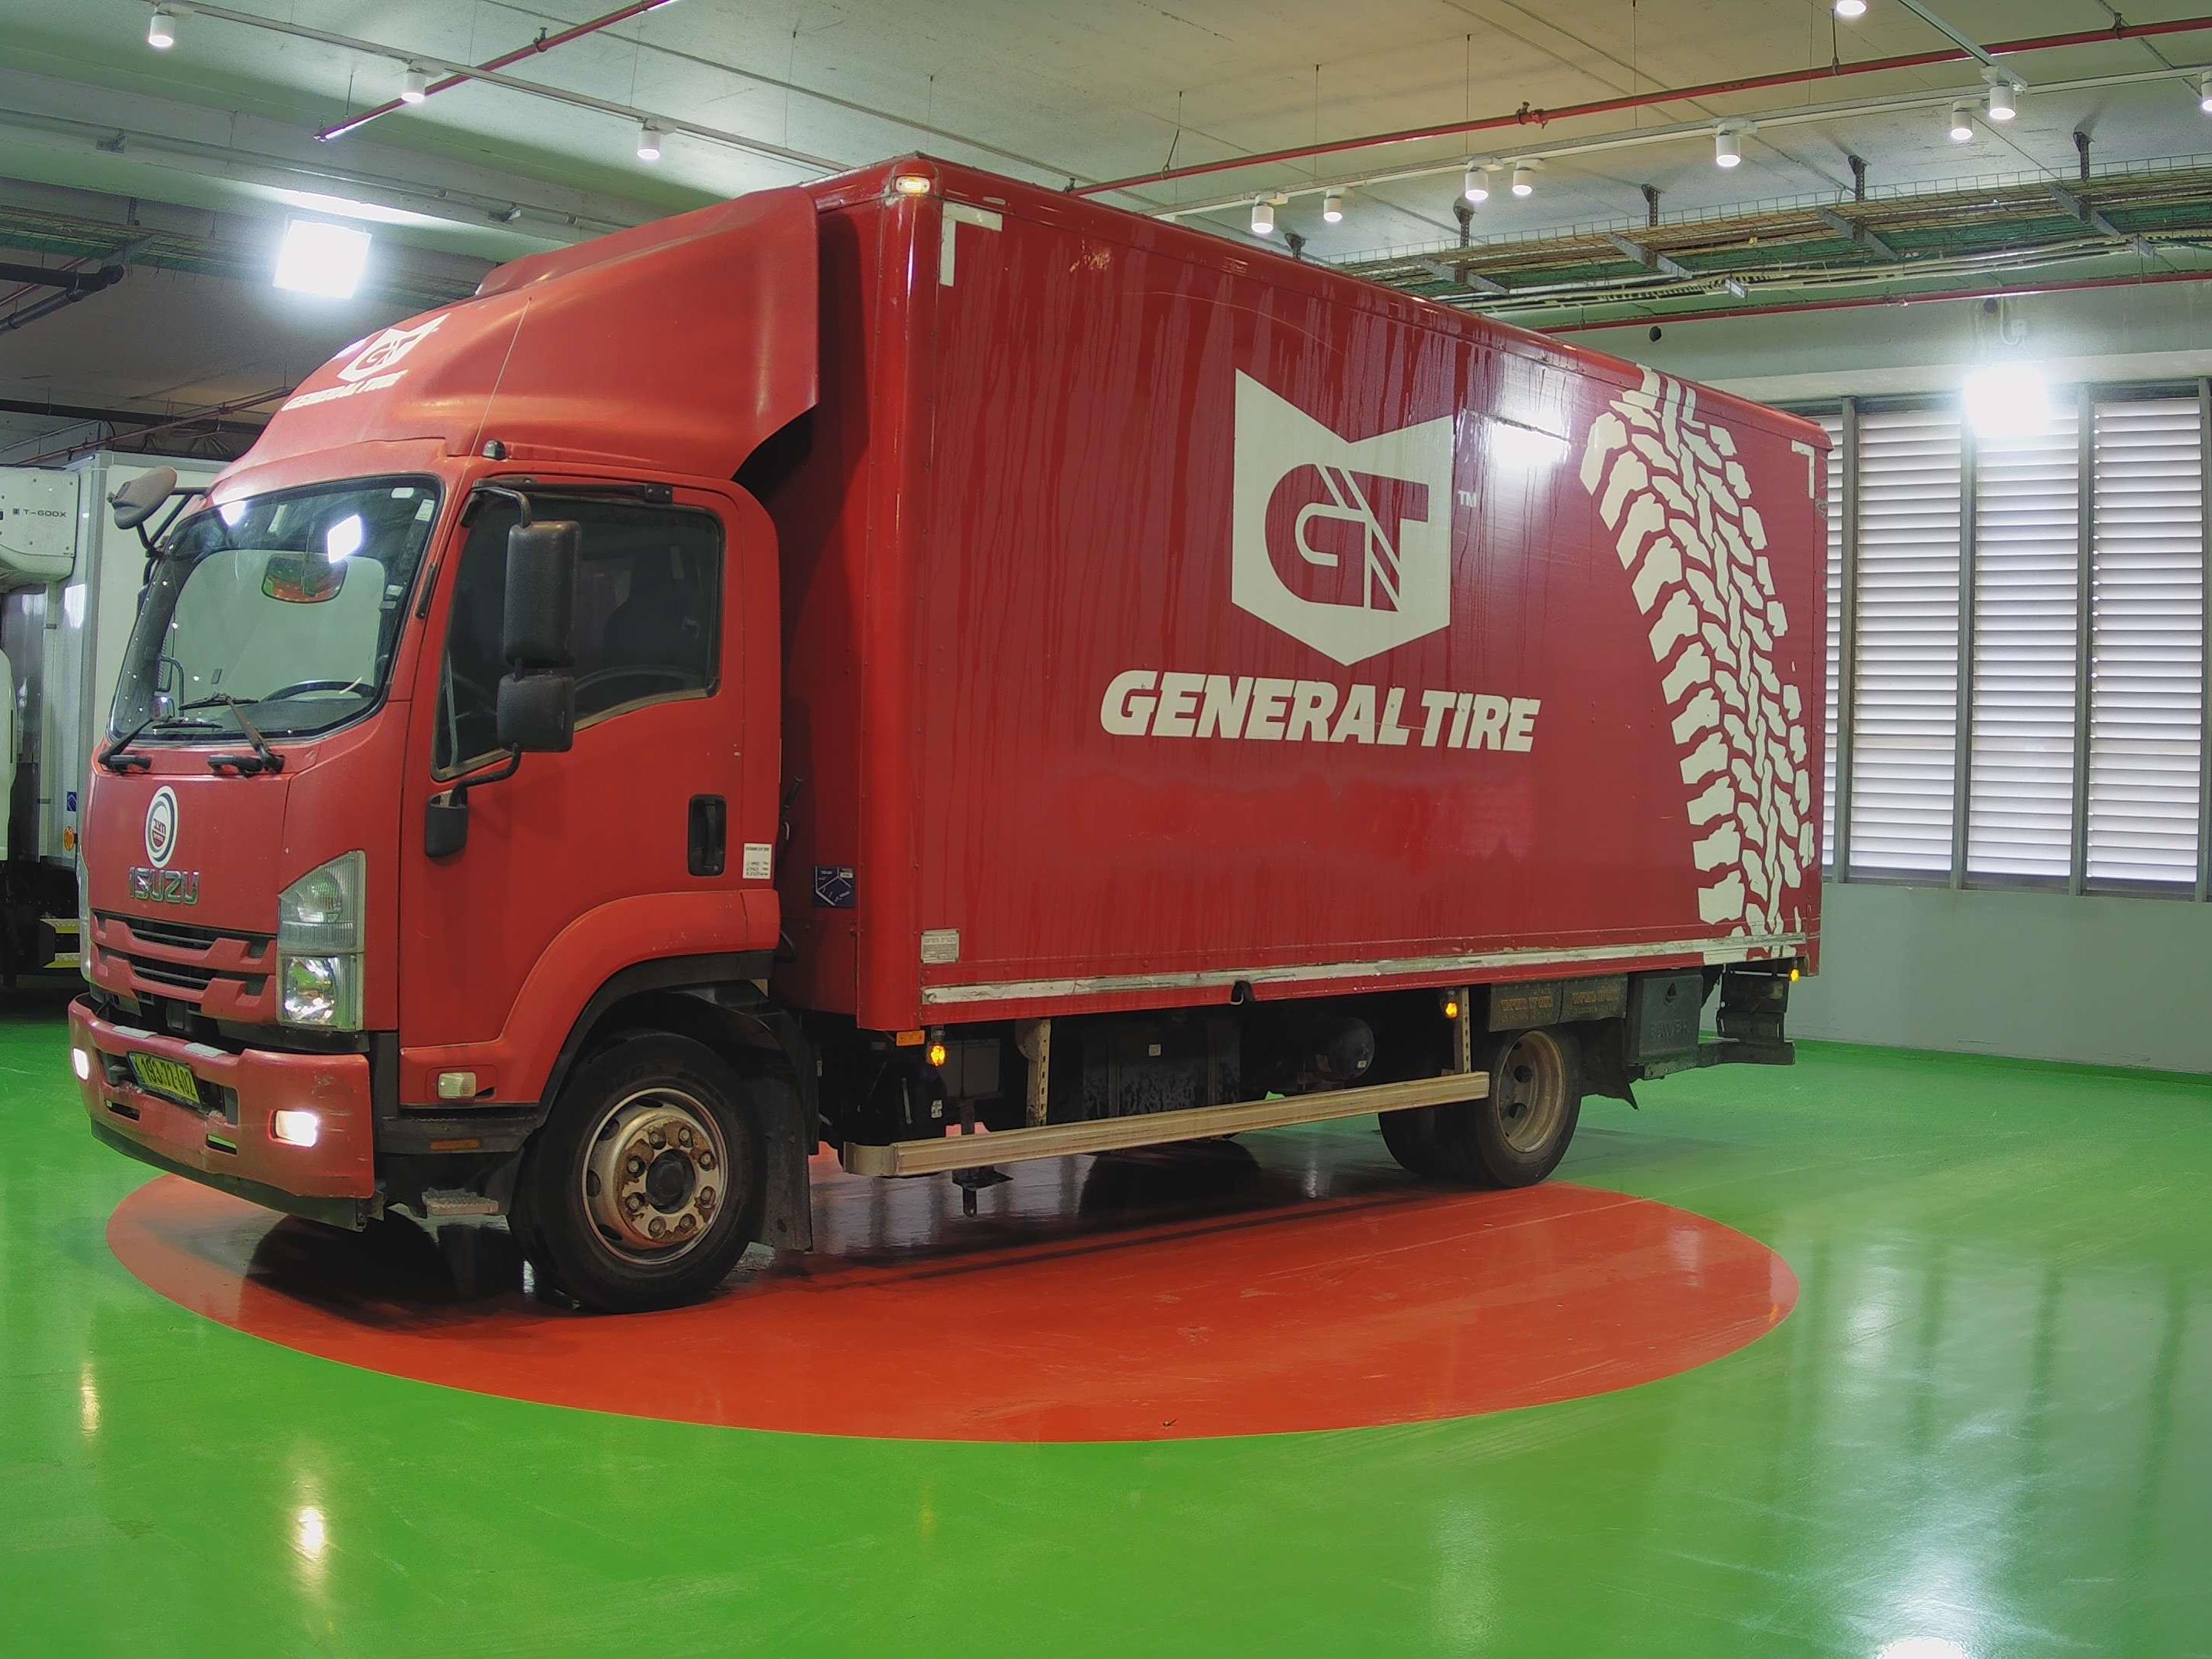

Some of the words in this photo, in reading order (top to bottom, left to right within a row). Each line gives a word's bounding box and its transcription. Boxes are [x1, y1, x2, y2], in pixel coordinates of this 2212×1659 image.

[1100, 669, 1412, 746] GENERAL
[1419, 688, 1542, 753] TIRE
[129, 867, 200, 904] ISUZU
